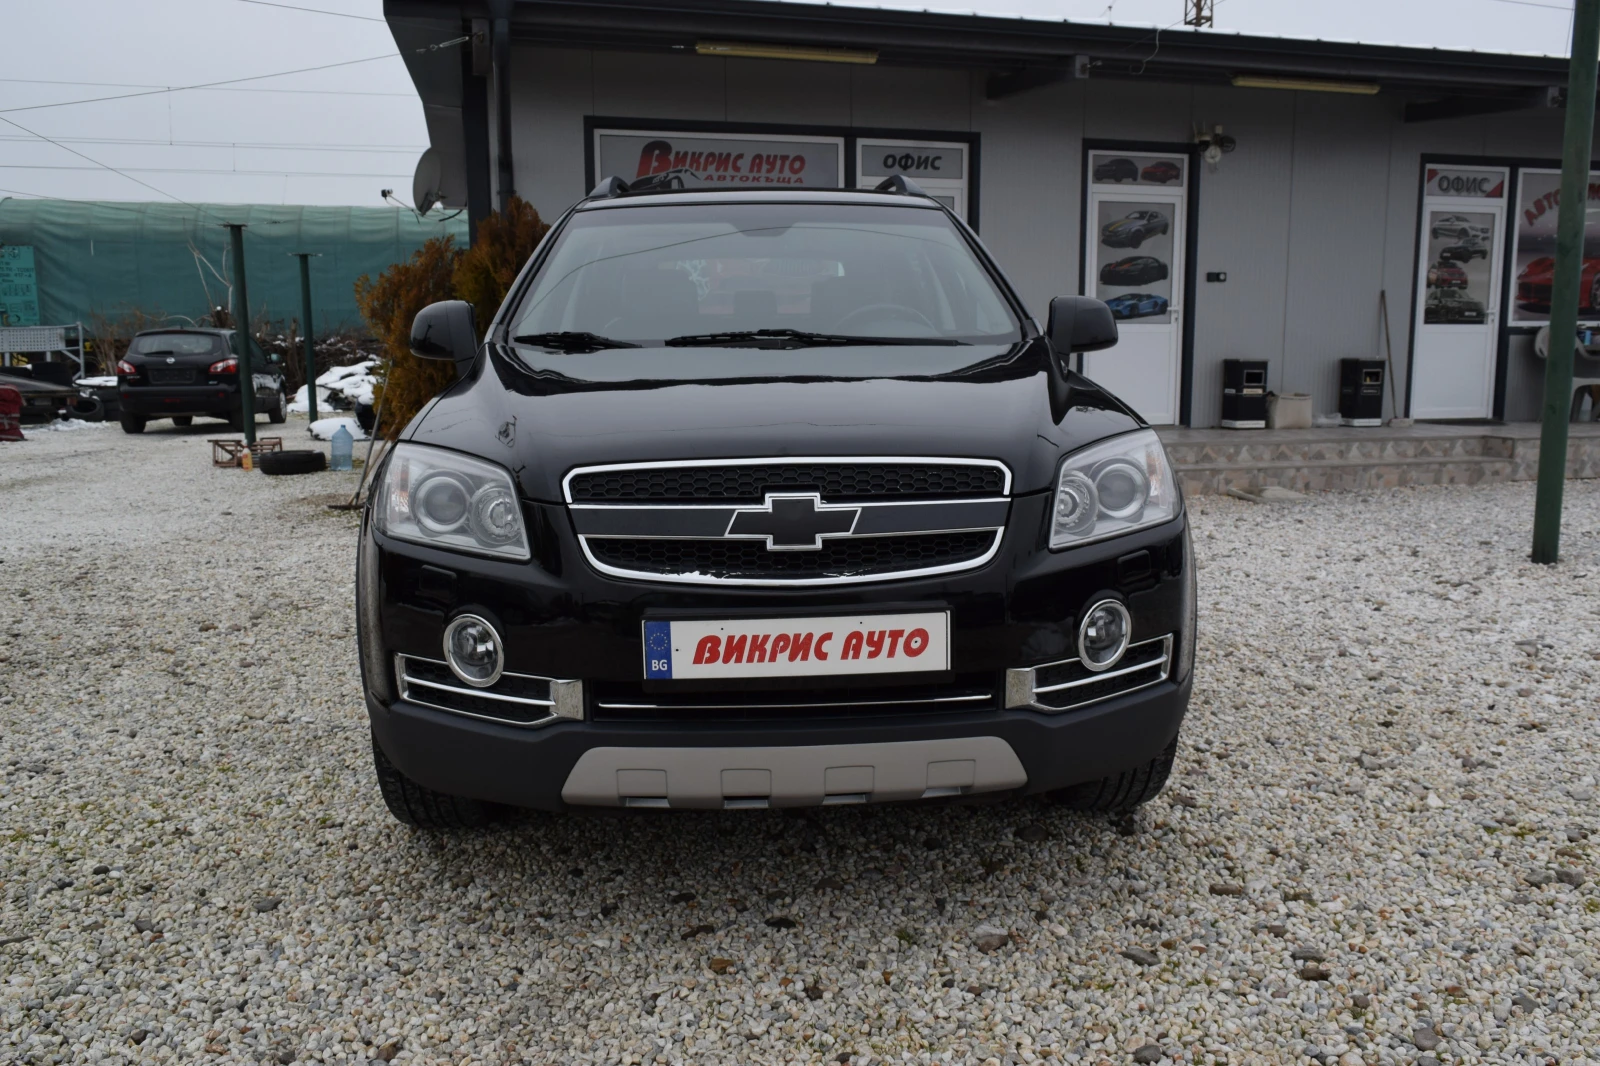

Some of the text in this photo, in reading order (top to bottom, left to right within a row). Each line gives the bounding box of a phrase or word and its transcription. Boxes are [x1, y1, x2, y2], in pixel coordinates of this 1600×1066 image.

[748, 153, 807, 176] АУТО
[882, 153, 943, 172] ОФИС
[703, 174, 804, 185] АВТОКЪЩА
[1438, 175, 1490, 194] ОФИС
[692, 628, 930, 665] ВИКРИС АУТО
[651, 659, 668, 671] BG
